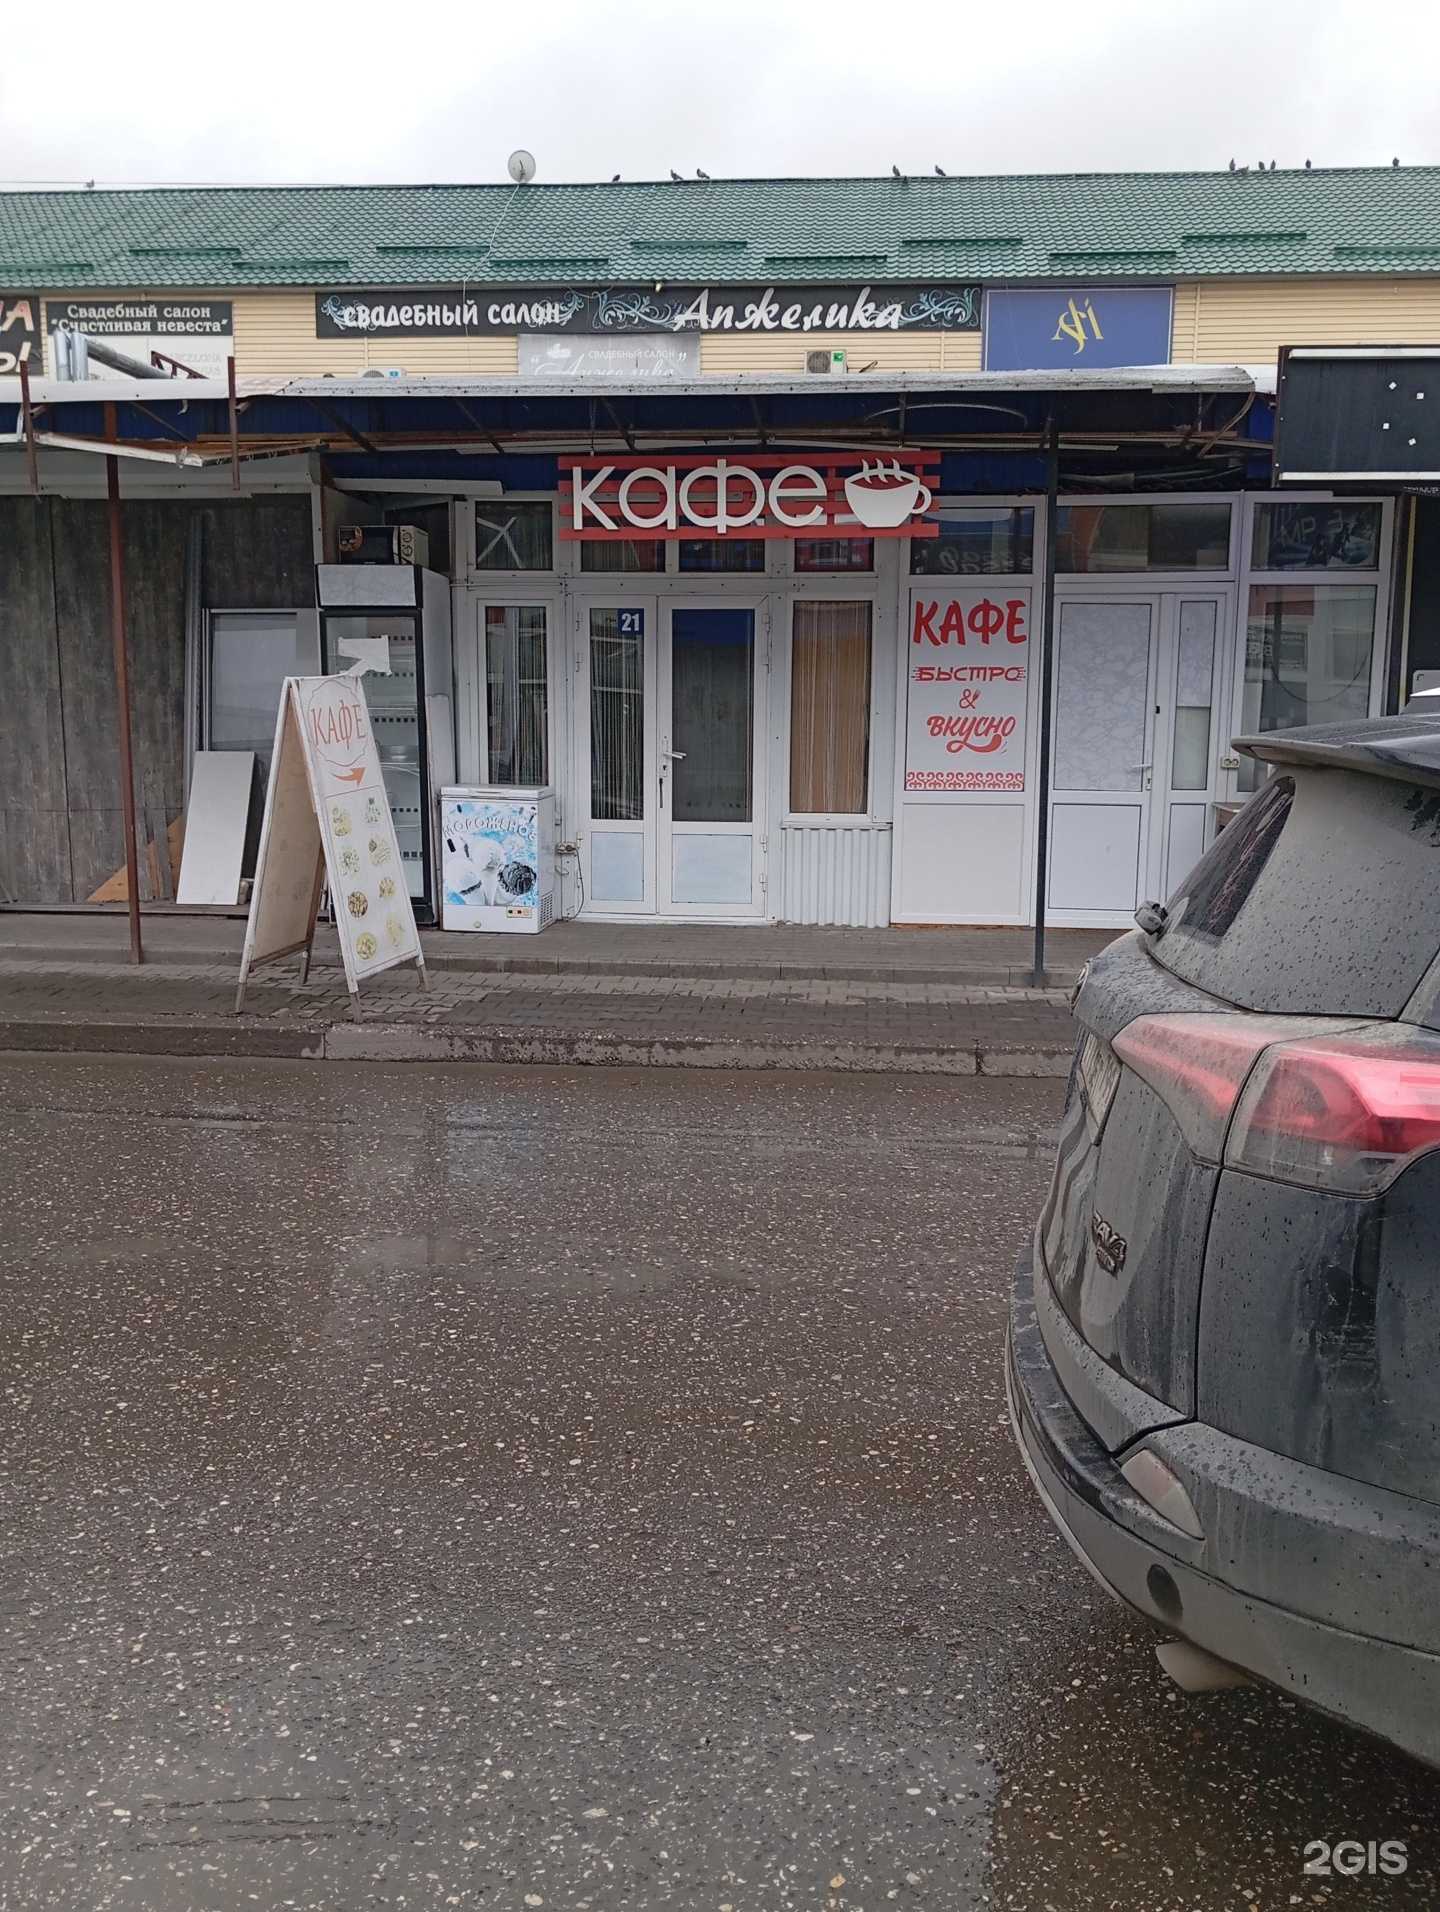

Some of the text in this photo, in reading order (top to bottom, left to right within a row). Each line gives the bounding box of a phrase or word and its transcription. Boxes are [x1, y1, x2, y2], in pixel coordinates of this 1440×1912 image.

[67, 303, 211, 319] Свадебный салон
[343, 300, 561, 328] свадебный салон
[621, 613, 640, 631] 21
[913, 599, 1027, 646] КАФЕ
[915, 666, 1023, 681] БЫСТРО
[311, 699, 366, 750] КАФЕ
[927, 715, 1016, 753] ВКУСНО
